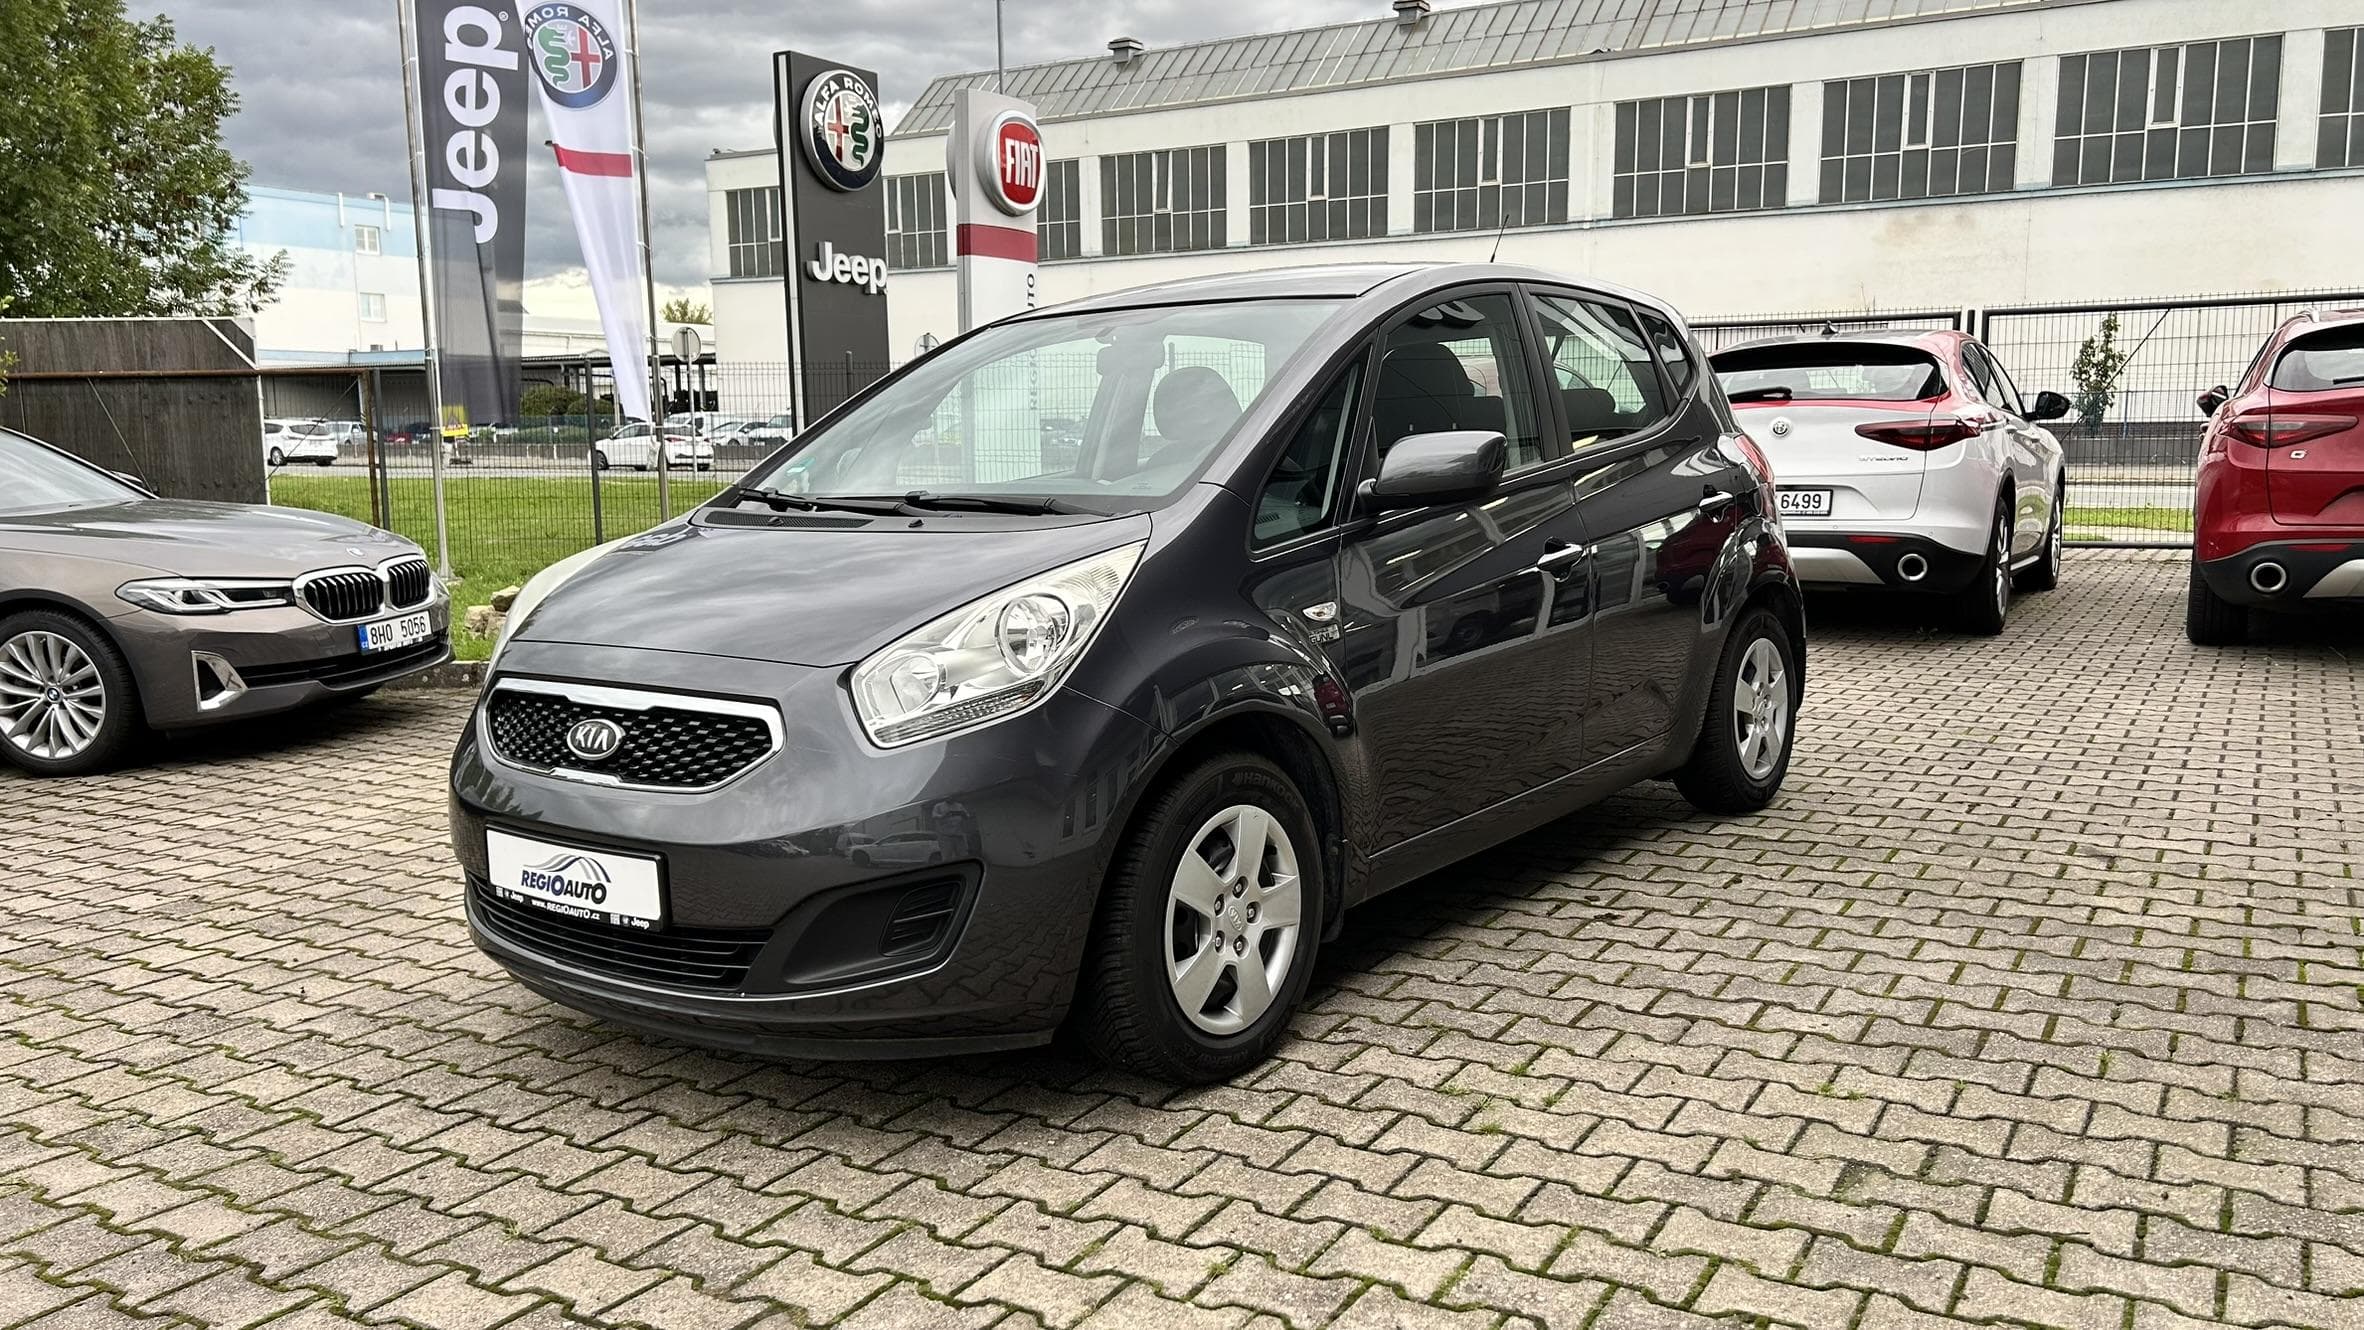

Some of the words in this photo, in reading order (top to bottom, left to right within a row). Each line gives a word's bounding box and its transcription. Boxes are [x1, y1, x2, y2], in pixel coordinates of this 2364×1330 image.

[432, 5, 519, 244] Jeep
[814, 80, 840, 127] ALFA
[843, 76, 882, 139] ROMEO
[1004, 137, 1039, 189] FIAT
[808, 240, 888, 294] Jeep
[1781, 493, 1822, 509] 6499
[400, 616, 426, 638] 5056
[576, 725, 609, 751] KIA
[521, 869, 607, 904] REGIOAUTO
[631, 916, 650, 930] Jeep
